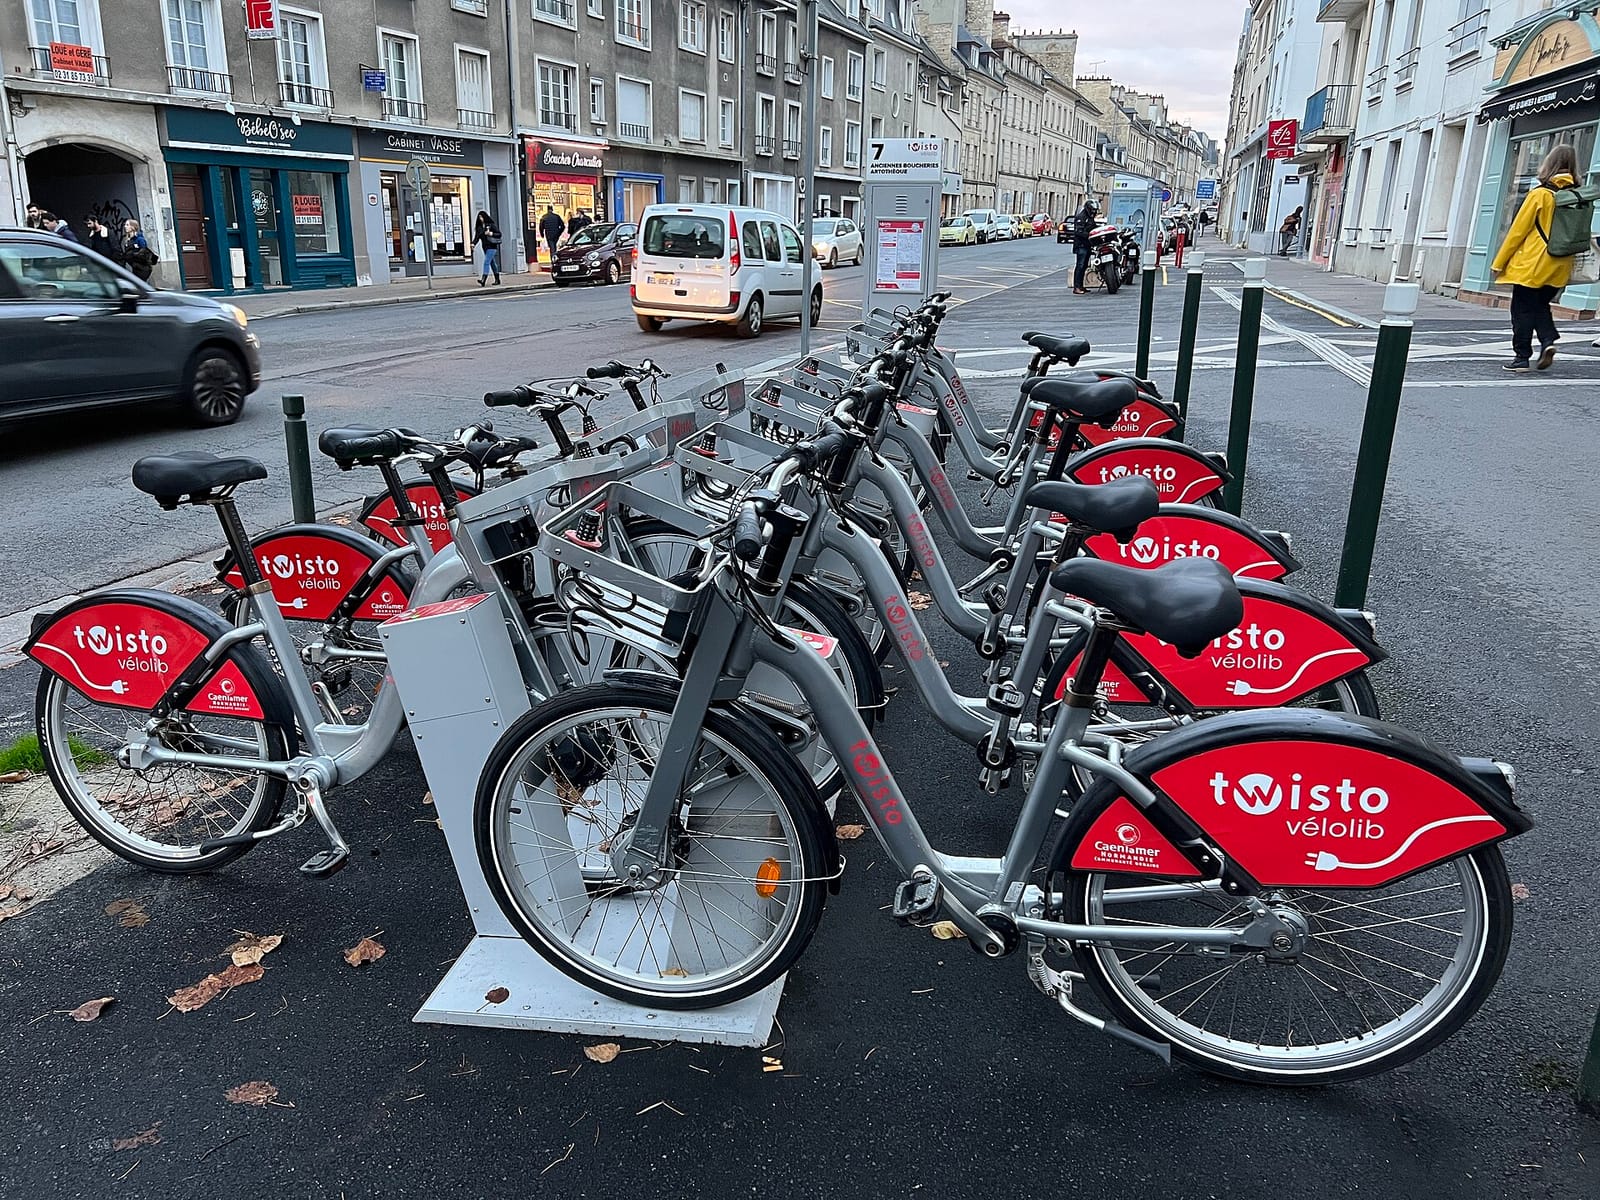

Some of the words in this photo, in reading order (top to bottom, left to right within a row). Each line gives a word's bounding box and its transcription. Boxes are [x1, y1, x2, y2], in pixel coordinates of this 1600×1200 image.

[53, 57, 73, 66] Cabinet
[55, 70, 62, 79] 02
[63, 71, 70, 79] 31
[430, 138, 462, 153] VASSE
[871, 144, 885, 161] 7
[907, 142, 939, 152] twisto
[300, 197, 320, 206] LOUER
[951, 375, 968, 405] twisto
[944, 393, 964, 427] twisto
[424, 520, 450, 531] vélol
[260, 553, 340, 579] twisto
[298, 577, 341, 590] vélolib
[883, 594, 924, 662] twisto
[73, 625, 168, 655] twisto
[118, 656, 168, 674] vélolib
[1211, 653, 1283, 671] vélolib
[848, 740, 903, 825] twisto
[1209, 772, 1389, 815] twisto
[1286, 816, 1385, 840] vélolib
[1101, 851, 1154, 863] NORMANDIE
